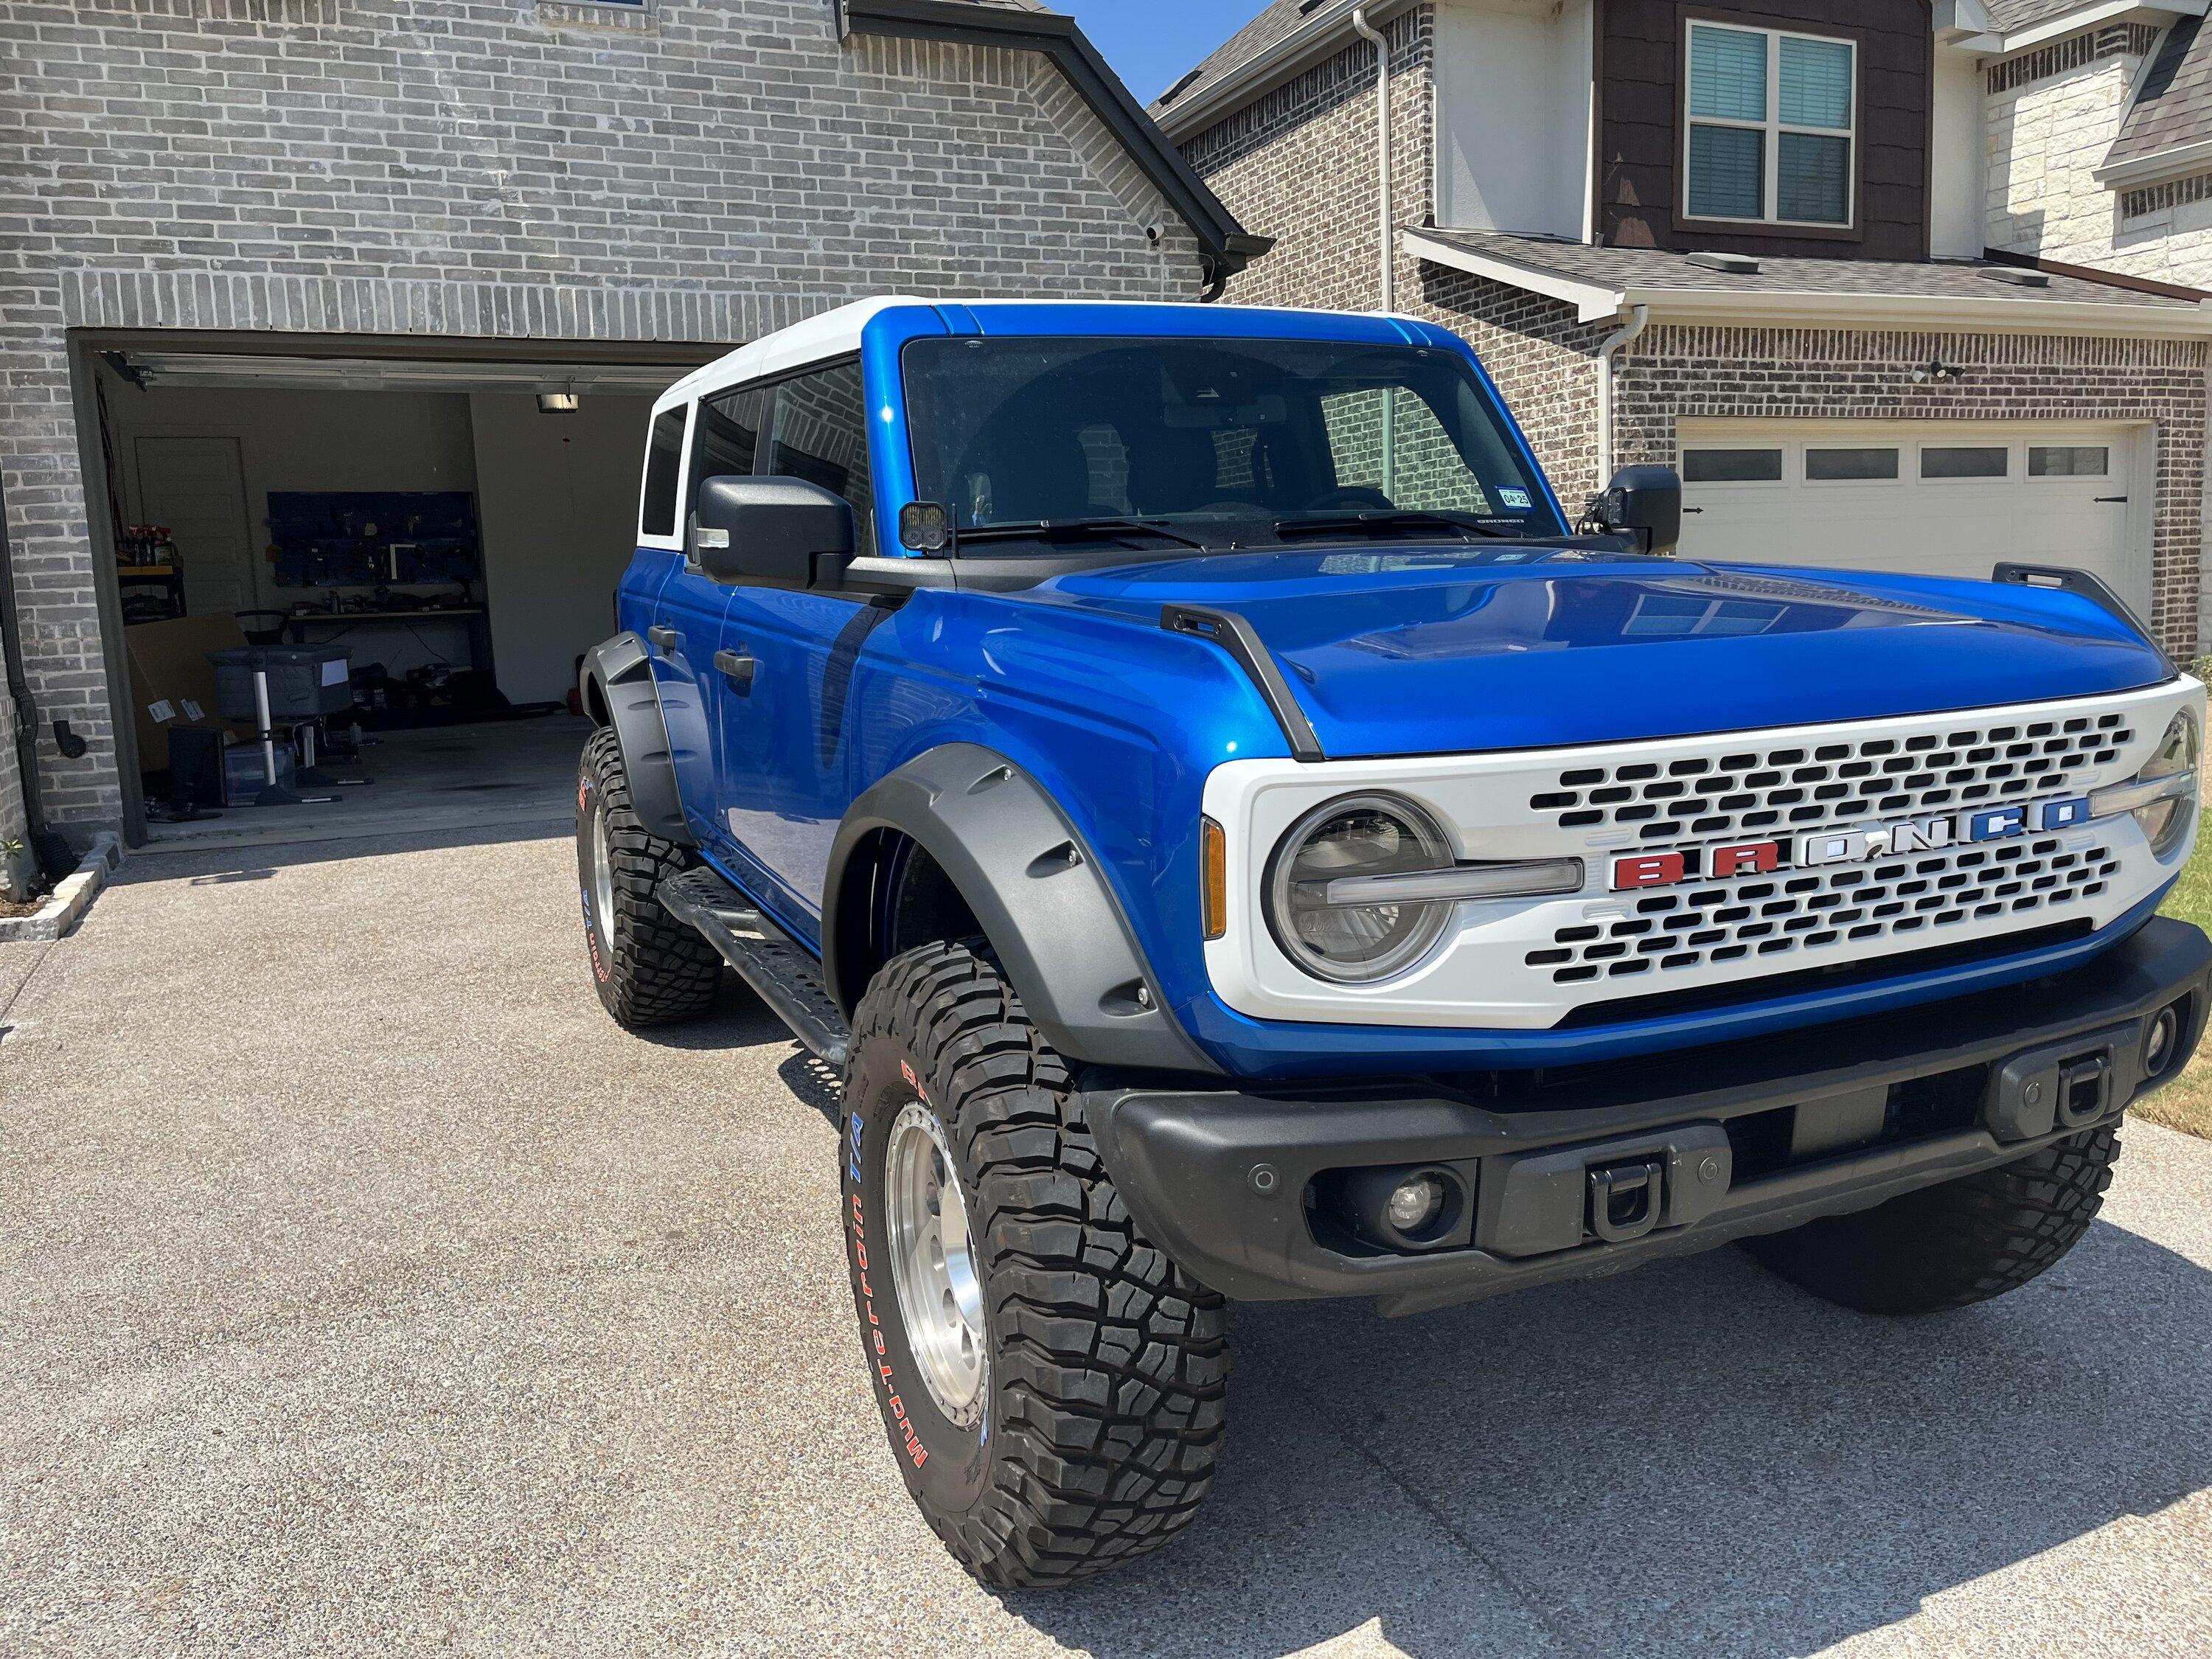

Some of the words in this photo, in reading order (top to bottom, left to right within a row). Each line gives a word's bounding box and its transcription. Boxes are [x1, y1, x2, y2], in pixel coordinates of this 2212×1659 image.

[1504, 495, 1515, 503] 04
[1517, 495, 1528, 504] 25
[1611, 796, 2090, 891] BRONCO
[849, 1112, 864, 1183] T/A
[851, 1194, 928, 1469] Mud-Terrain
